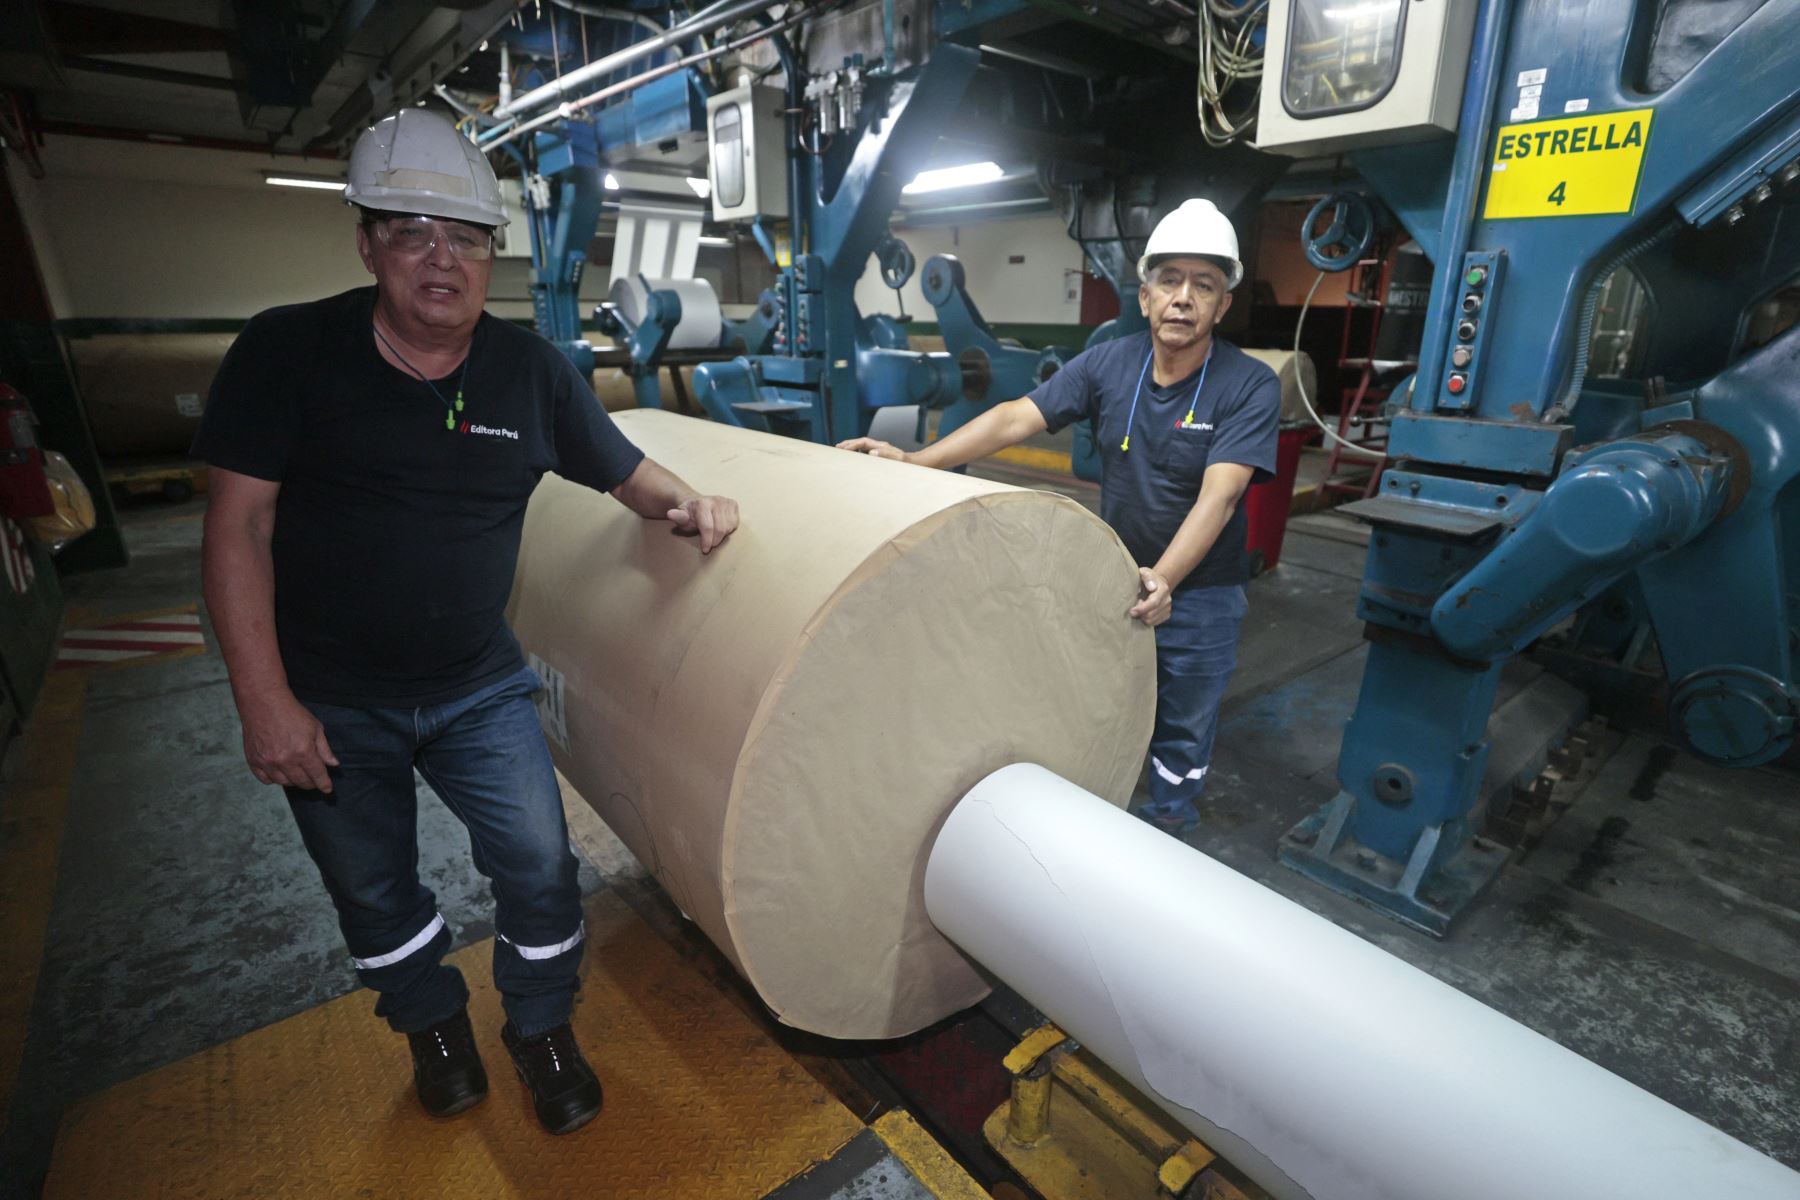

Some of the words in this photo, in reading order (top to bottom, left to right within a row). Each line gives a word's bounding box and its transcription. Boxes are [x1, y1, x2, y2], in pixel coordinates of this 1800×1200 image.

[1498, 121, 1642, 160] ESTRELLA
[1547, 181, 1567, 206] 4
[470, 424, 501, 435] Editora
[502, 428, 519, 439] Perú
